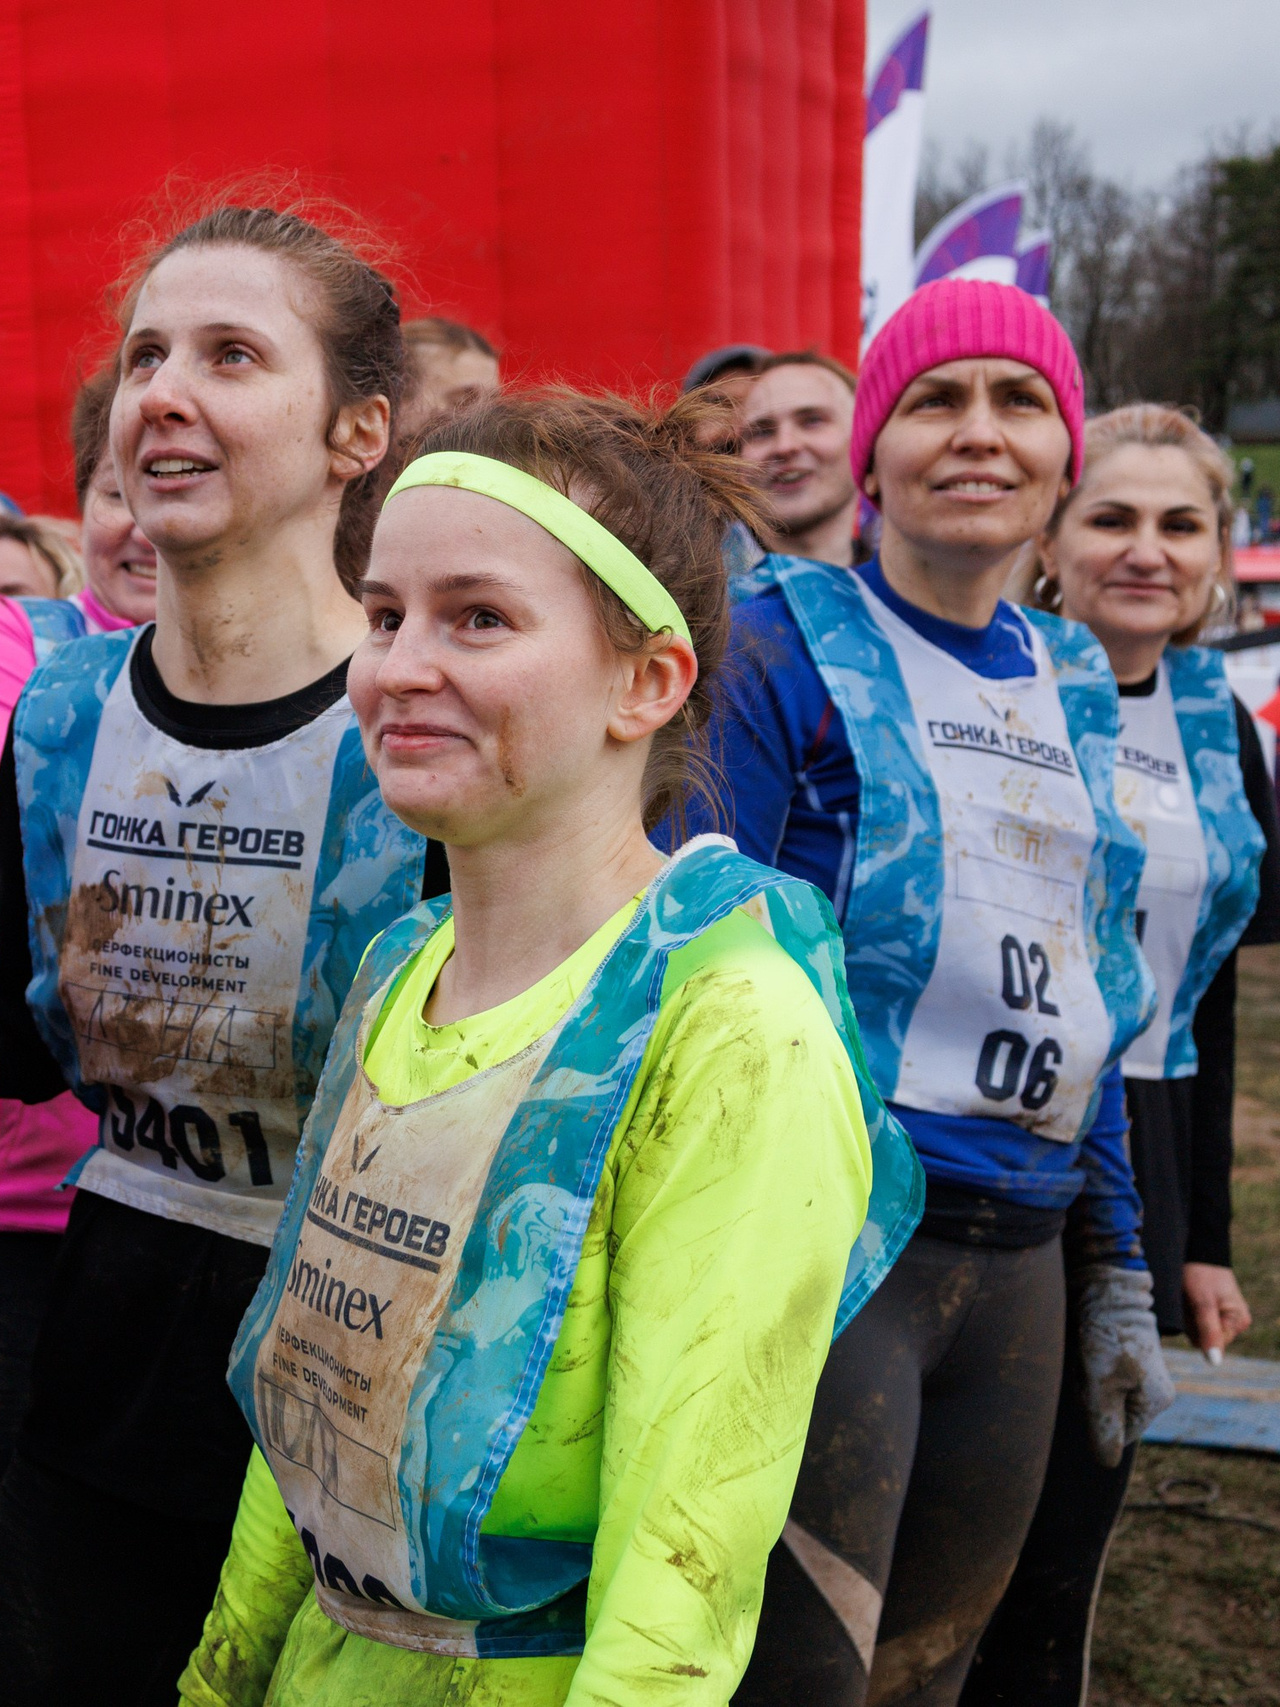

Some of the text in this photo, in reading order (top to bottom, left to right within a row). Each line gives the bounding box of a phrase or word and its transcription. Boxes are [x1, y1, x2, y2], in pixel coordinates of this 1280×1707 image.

[927, 720, 1074, 769] ГОНКА ГЕРОЕВ
[1119, 744, 1179, 777] ЕРОЕВ
[88, 809, 305, 858] ГОНКА ГЕРОЕВ
[99, 869, 256, 928] Sminex
[90, 962, 247, 994] FINE DEVELOPMENT
[1000, 934, 1061, 1018] 02
[975, 1028, 1063, 1111] 06
[340, 1191, 451, 1258] ГЕРОЕВ
[272, 1352, 369, 1424] FINE DEVELOPMENT
